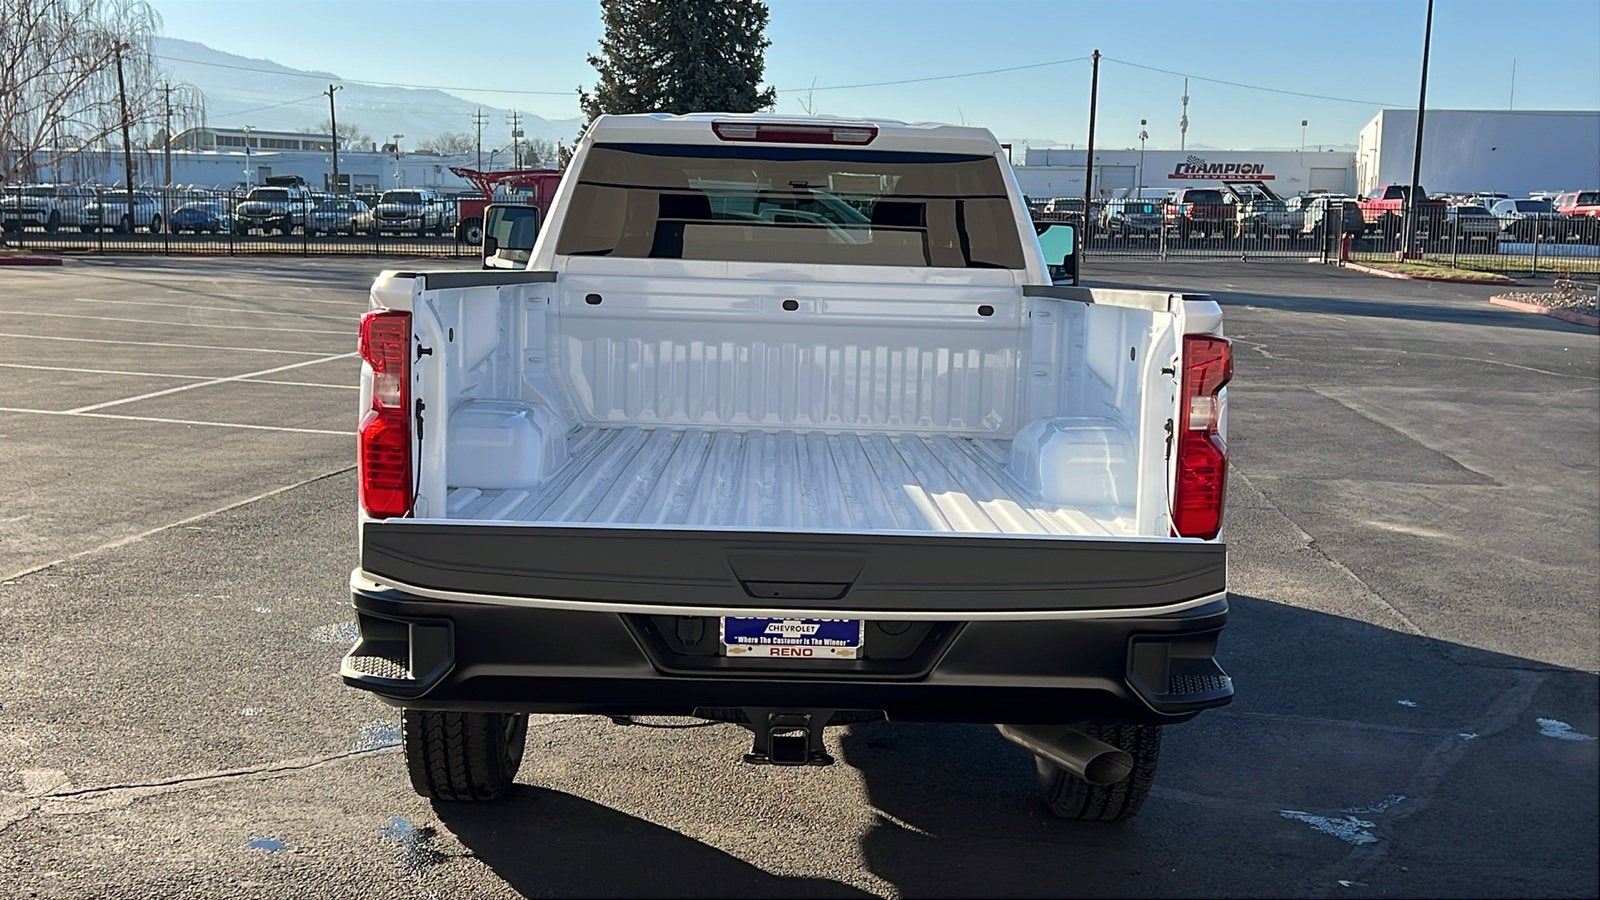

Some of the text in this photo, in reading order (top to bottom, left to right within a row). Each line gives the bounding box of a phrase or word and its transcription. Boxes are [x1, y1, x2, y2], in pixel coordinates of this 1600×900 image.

[1174, 163, 1264, 175] CHAMPION
[768, 625, 815, 633] CHEVROLET
[760, 636, 771, 644] The
[772, 637, 802, 645] Customer
[770, 648, 813, 656] RENO
